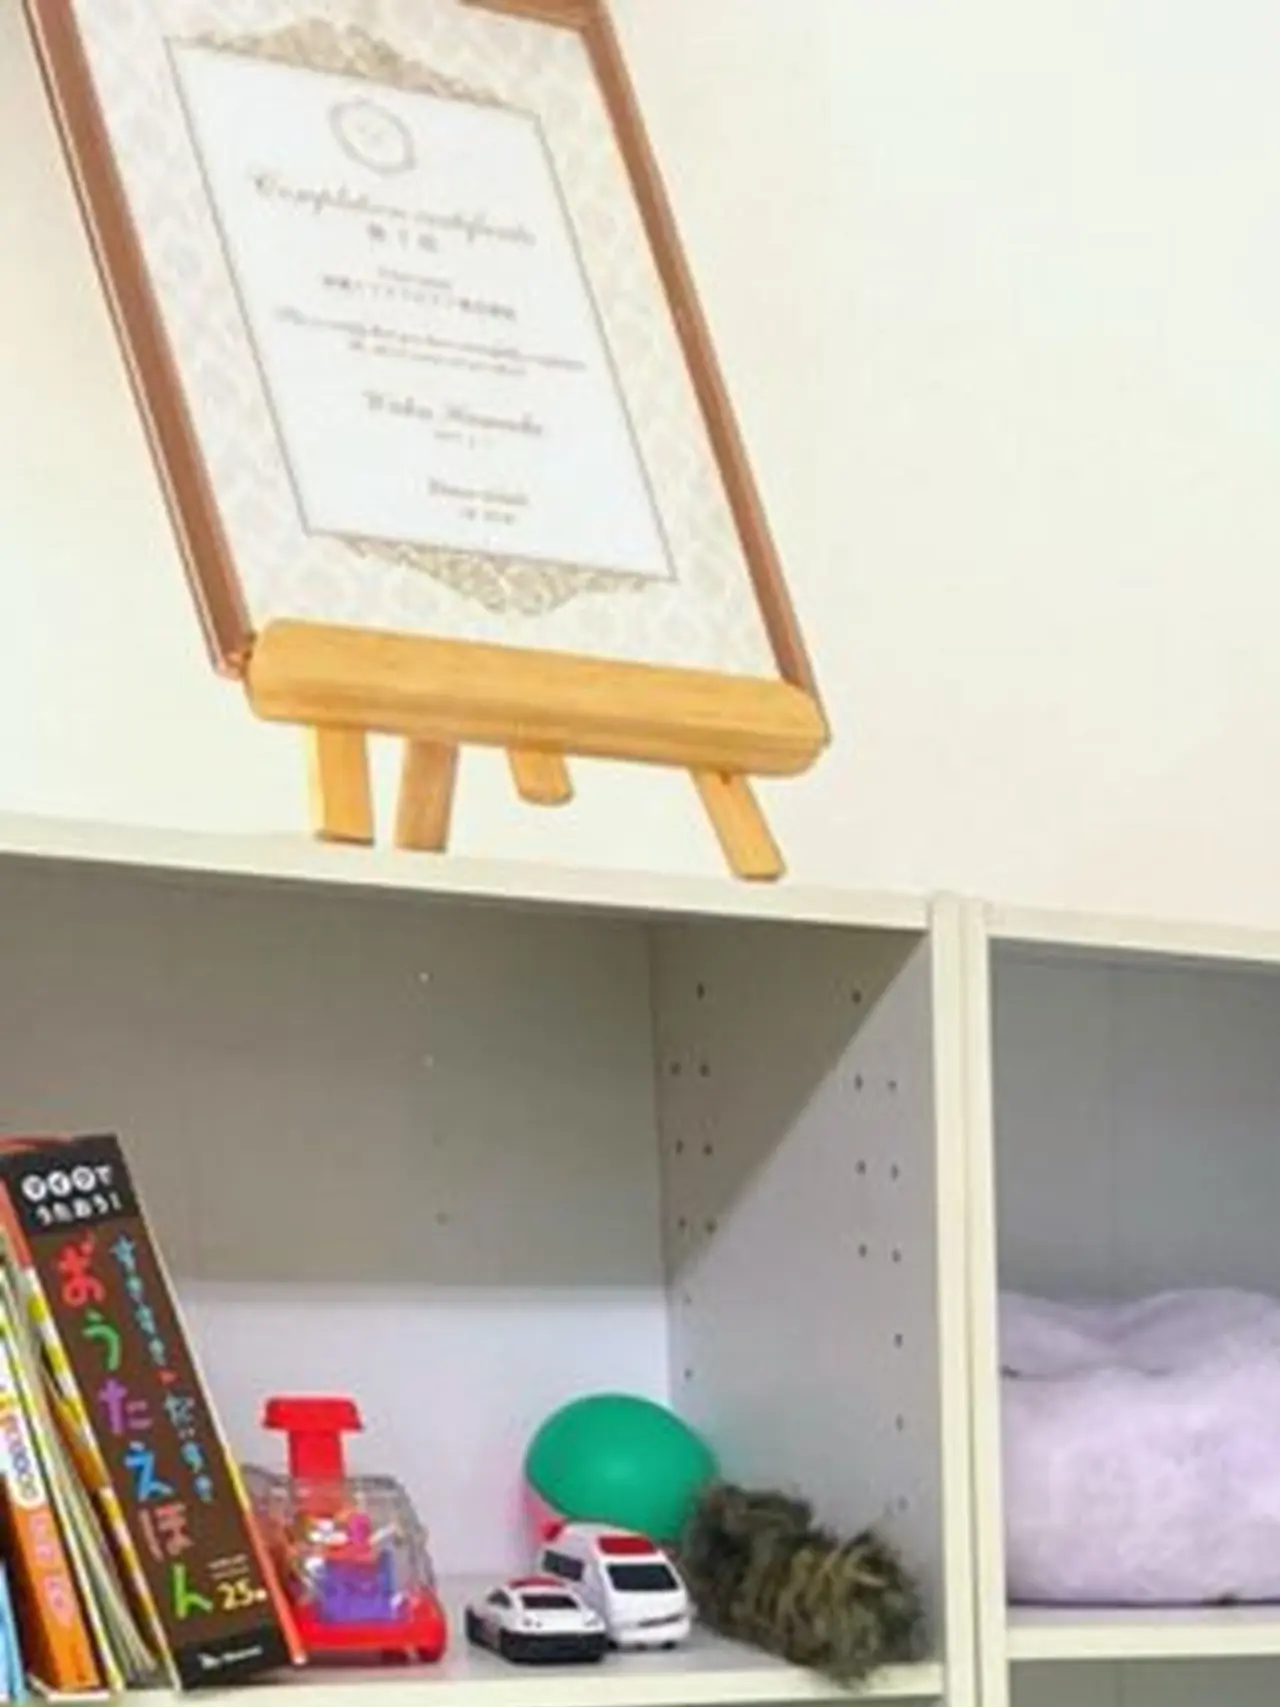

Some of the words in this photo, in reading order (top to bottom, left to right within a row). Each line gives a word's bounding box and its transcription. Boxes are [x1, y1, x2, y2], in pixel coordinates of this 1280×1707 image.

[59, 1233, 213, 1619] おうたえほん
